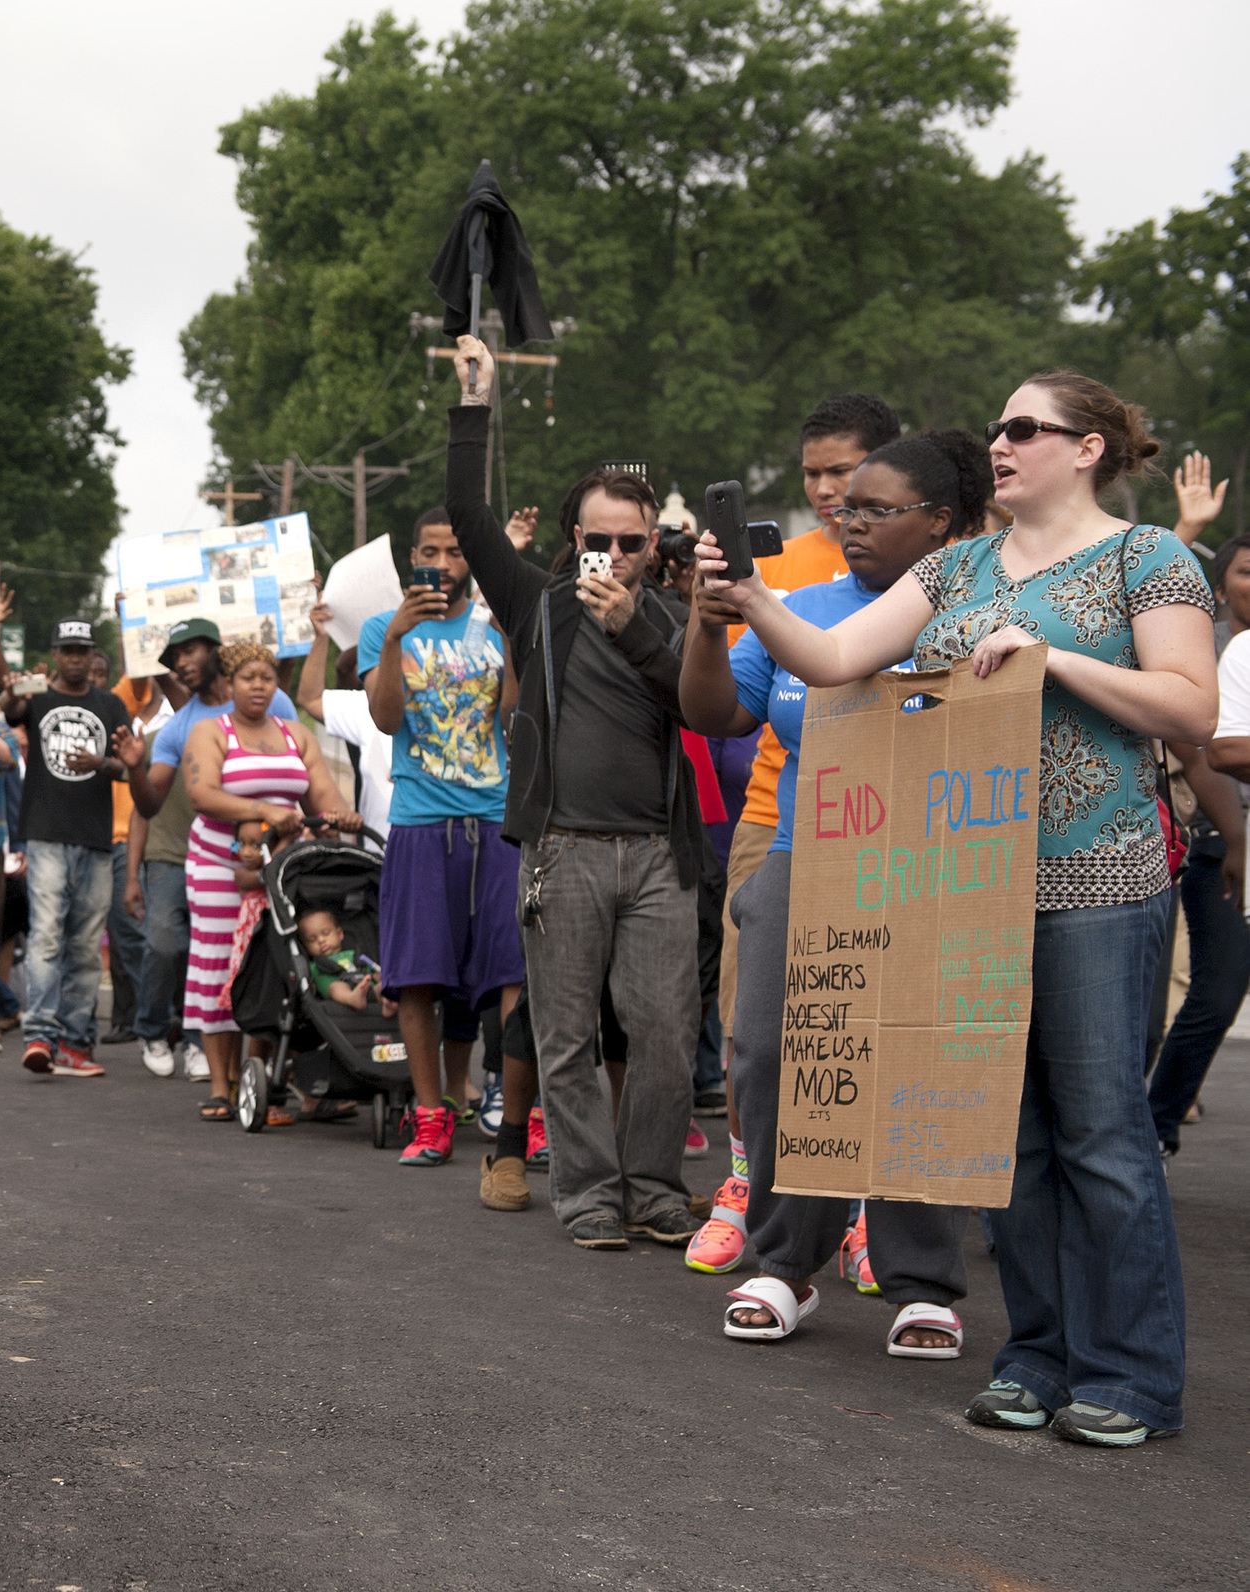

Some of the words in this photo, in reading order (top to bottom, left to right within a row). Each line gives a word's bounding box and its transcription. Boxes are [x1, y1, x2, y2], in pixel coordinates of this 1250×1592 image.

[776, 689, 804, 701] New
[816, 766, 886, 839] END
[926, 766, 1030, 838] POLICE
[855, 837, 1015, 911] BRUTALITY
[793, 925, 823, 957] WE
[826, 923, 891, 953] DEMAND
[940, 927, 995, 956] WHERE
[999, 925, 1027, 949] ARE
[786, 961, 867, 1000] ANSWERS
[940, 957, 971, 983] YOUR
[977, 952, 1030, 993] TANKS
[954, 993, 1021, 1035] DOGS
[783, 1034, 831, 1063] MAKE
[833, 1036, 855, 1061] US
[857, 1036, 873, 1063] A
[940, 1037, 1005, 1064] TODAY?
[793, 1065, 858, 1107] MOB
[890, 1082, 988, 1113] #FERGUSON
[808, 1110, 831, 1122] IT'S
[886, 1118, 945, 1148] #STL
[780, 1129, 862, 1164] DEMOCRACY
